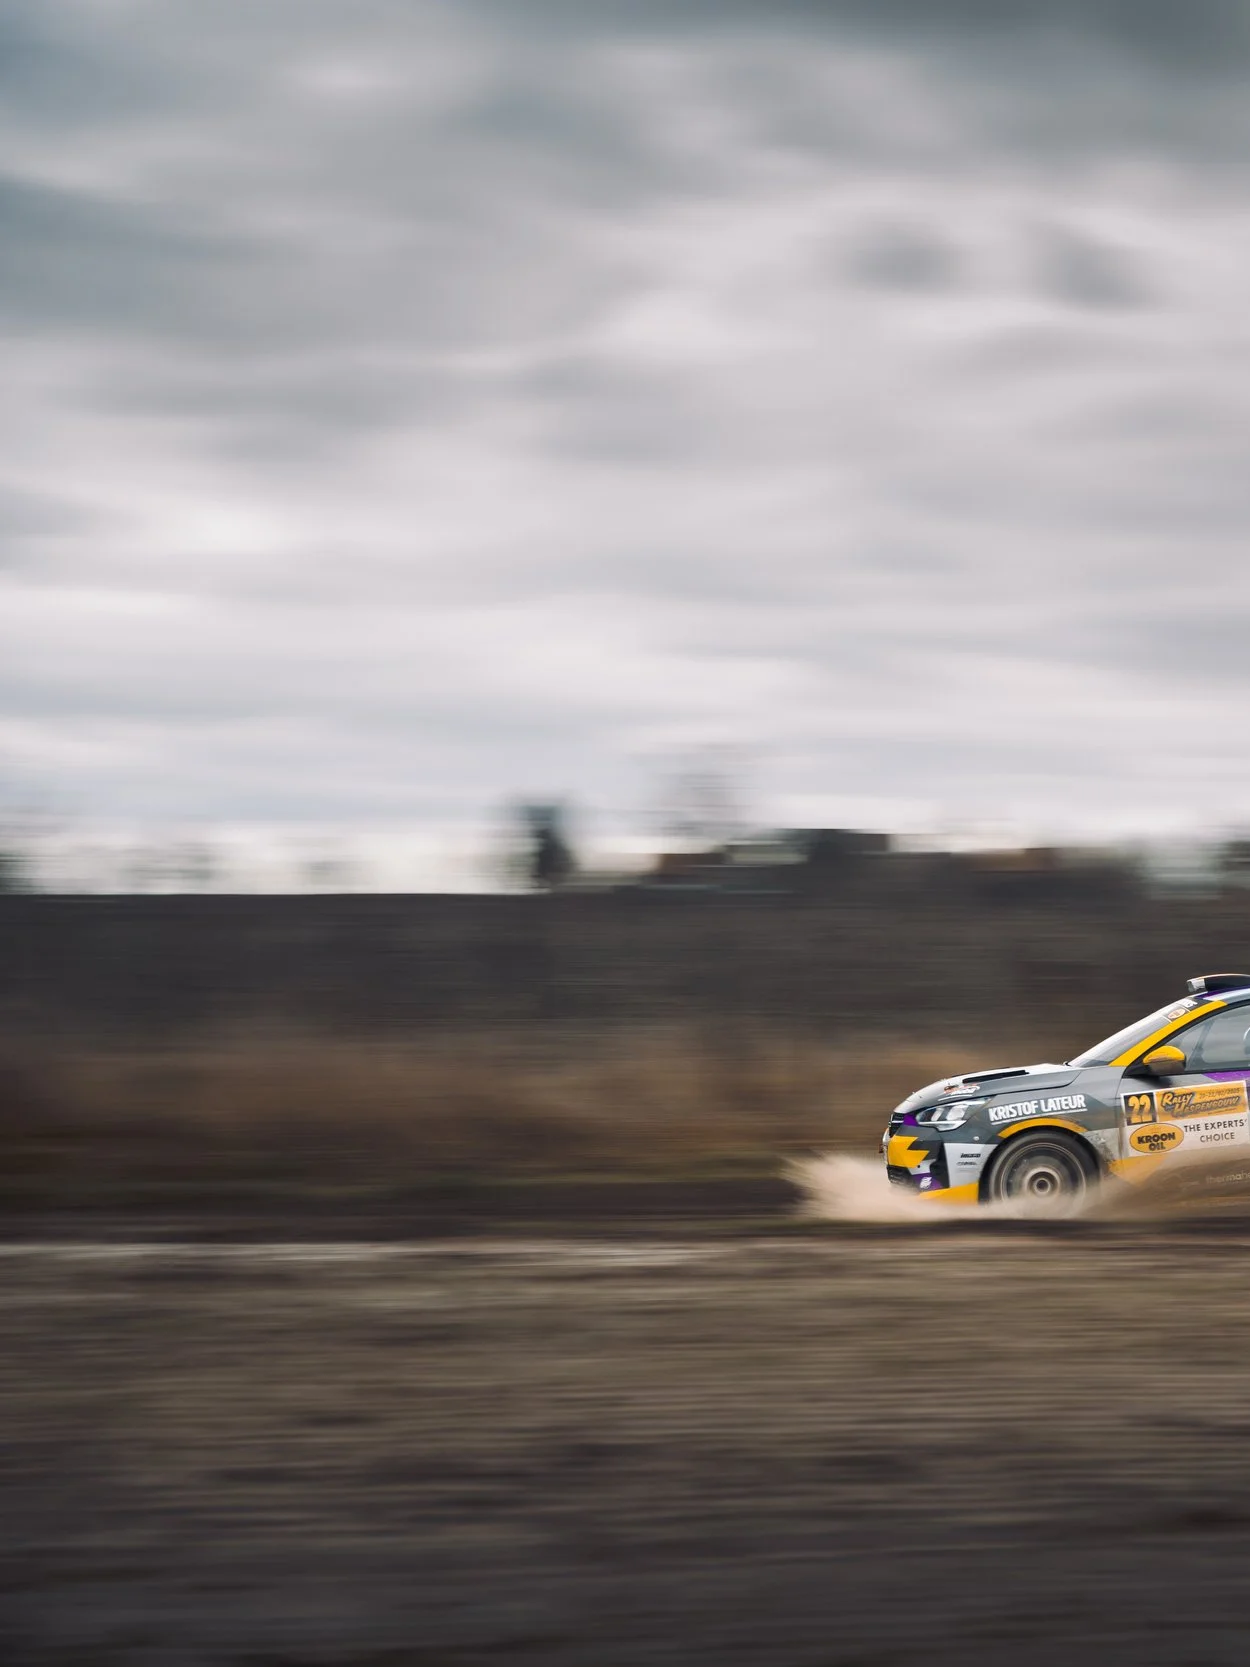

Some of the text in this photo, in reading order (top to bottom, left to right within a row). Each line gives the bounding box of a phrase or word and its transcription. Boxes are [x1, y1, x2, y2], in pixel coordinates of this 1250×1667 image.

[1162, 1092, 1193, 1107] RALLY
[988, 1094, 1086, 1121] KRISTOF LATEUR
[1128, 1094, 1152, 1123] 22
[1184, 1124, 1201, 1132] THE
[1137, 1131, 1176, 1144] KROON
[1200, 1131, 1235, 1143] CHOICE
[1148, 1142, 1166, 1151] OIL
